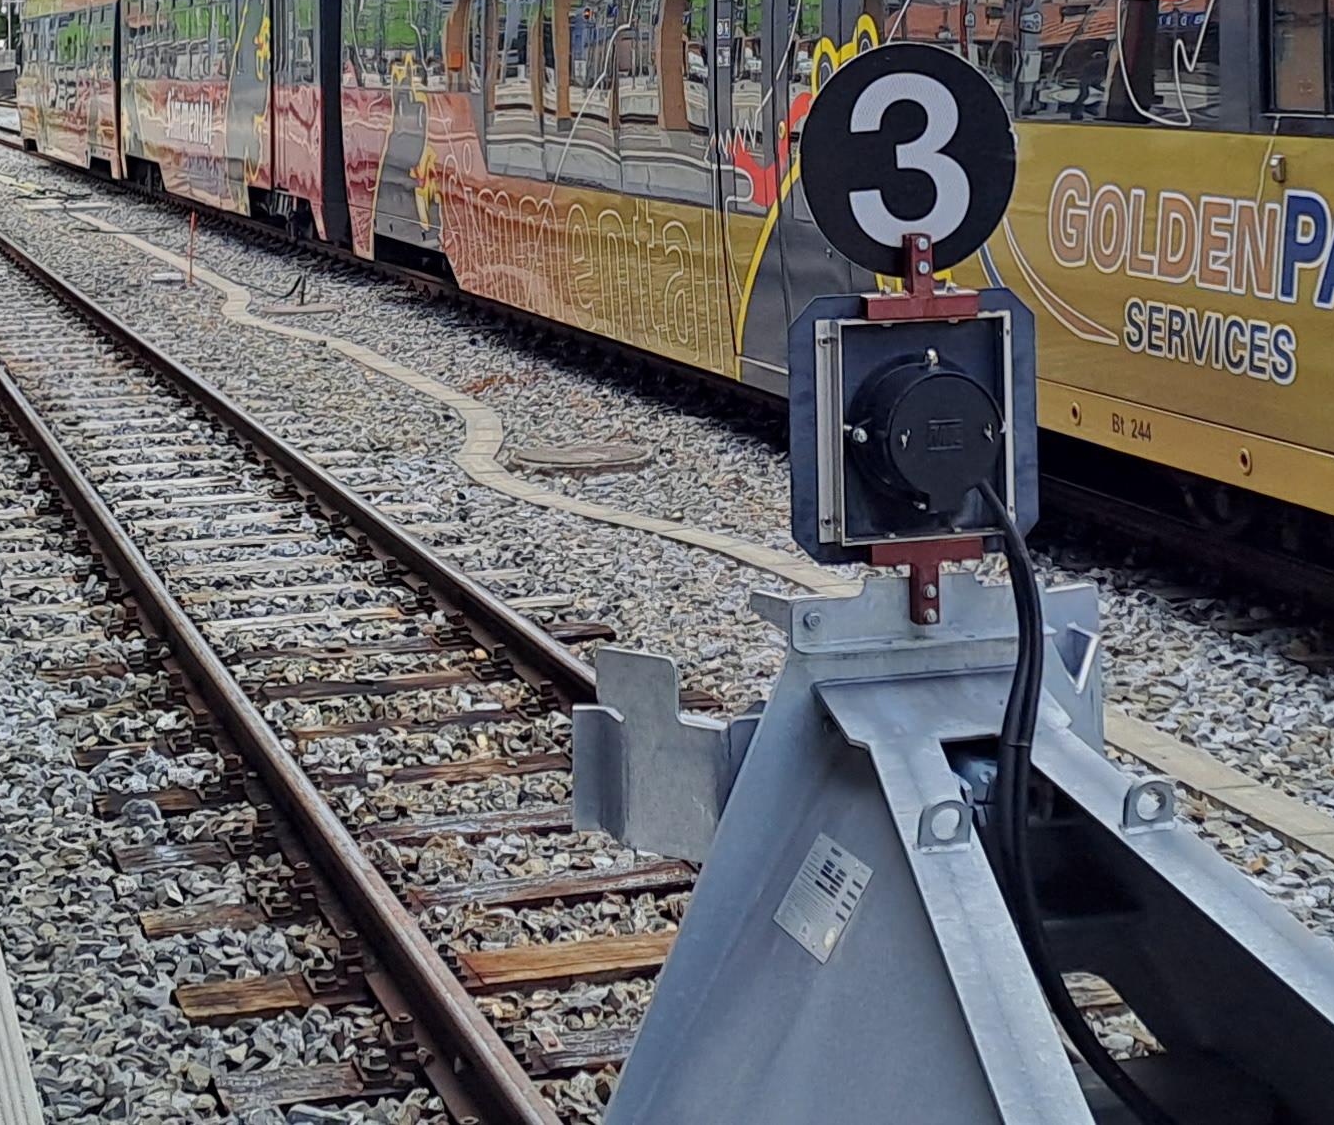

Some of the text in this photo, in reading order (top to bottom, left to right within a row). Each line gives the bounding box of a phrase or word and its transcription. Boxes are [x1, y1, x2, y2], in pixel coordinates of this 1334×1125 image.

[849, 72, 971, 249] 3
[1122, 297, 1298, 386] SERVICES
[1130, 418, 1152, 443] 244
